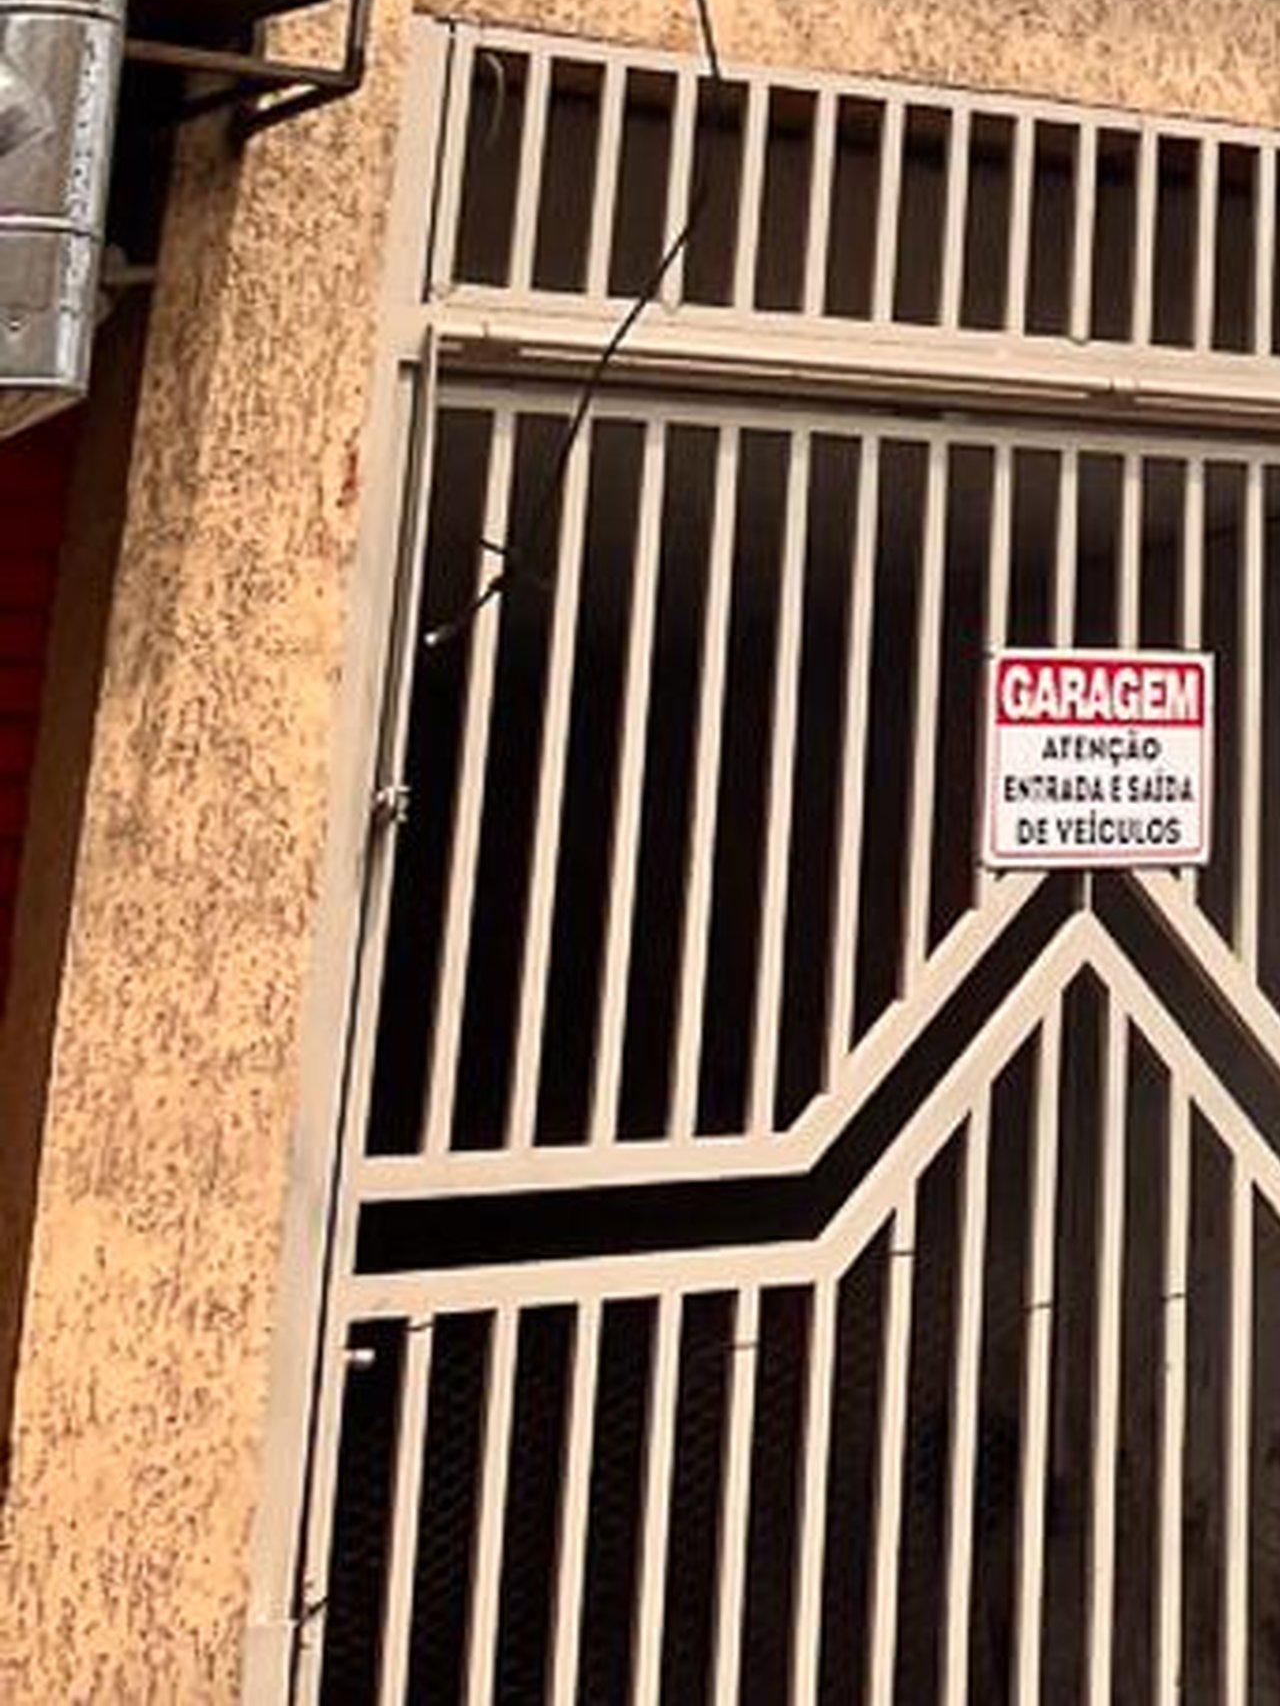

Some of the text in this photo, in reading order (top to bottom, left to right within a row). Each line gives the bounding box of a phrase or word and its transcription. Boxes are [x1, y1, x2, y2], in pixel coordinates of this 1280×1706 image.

[1001, 664, 1200, 722] GARAGEM
[1041, 730, 1161, 766] ATENÇÃO
[1003, 767, 1195, 803] ENTRADA E SAÍDA
[1016, 809, 1183, 847] DE VEÍCULOS
